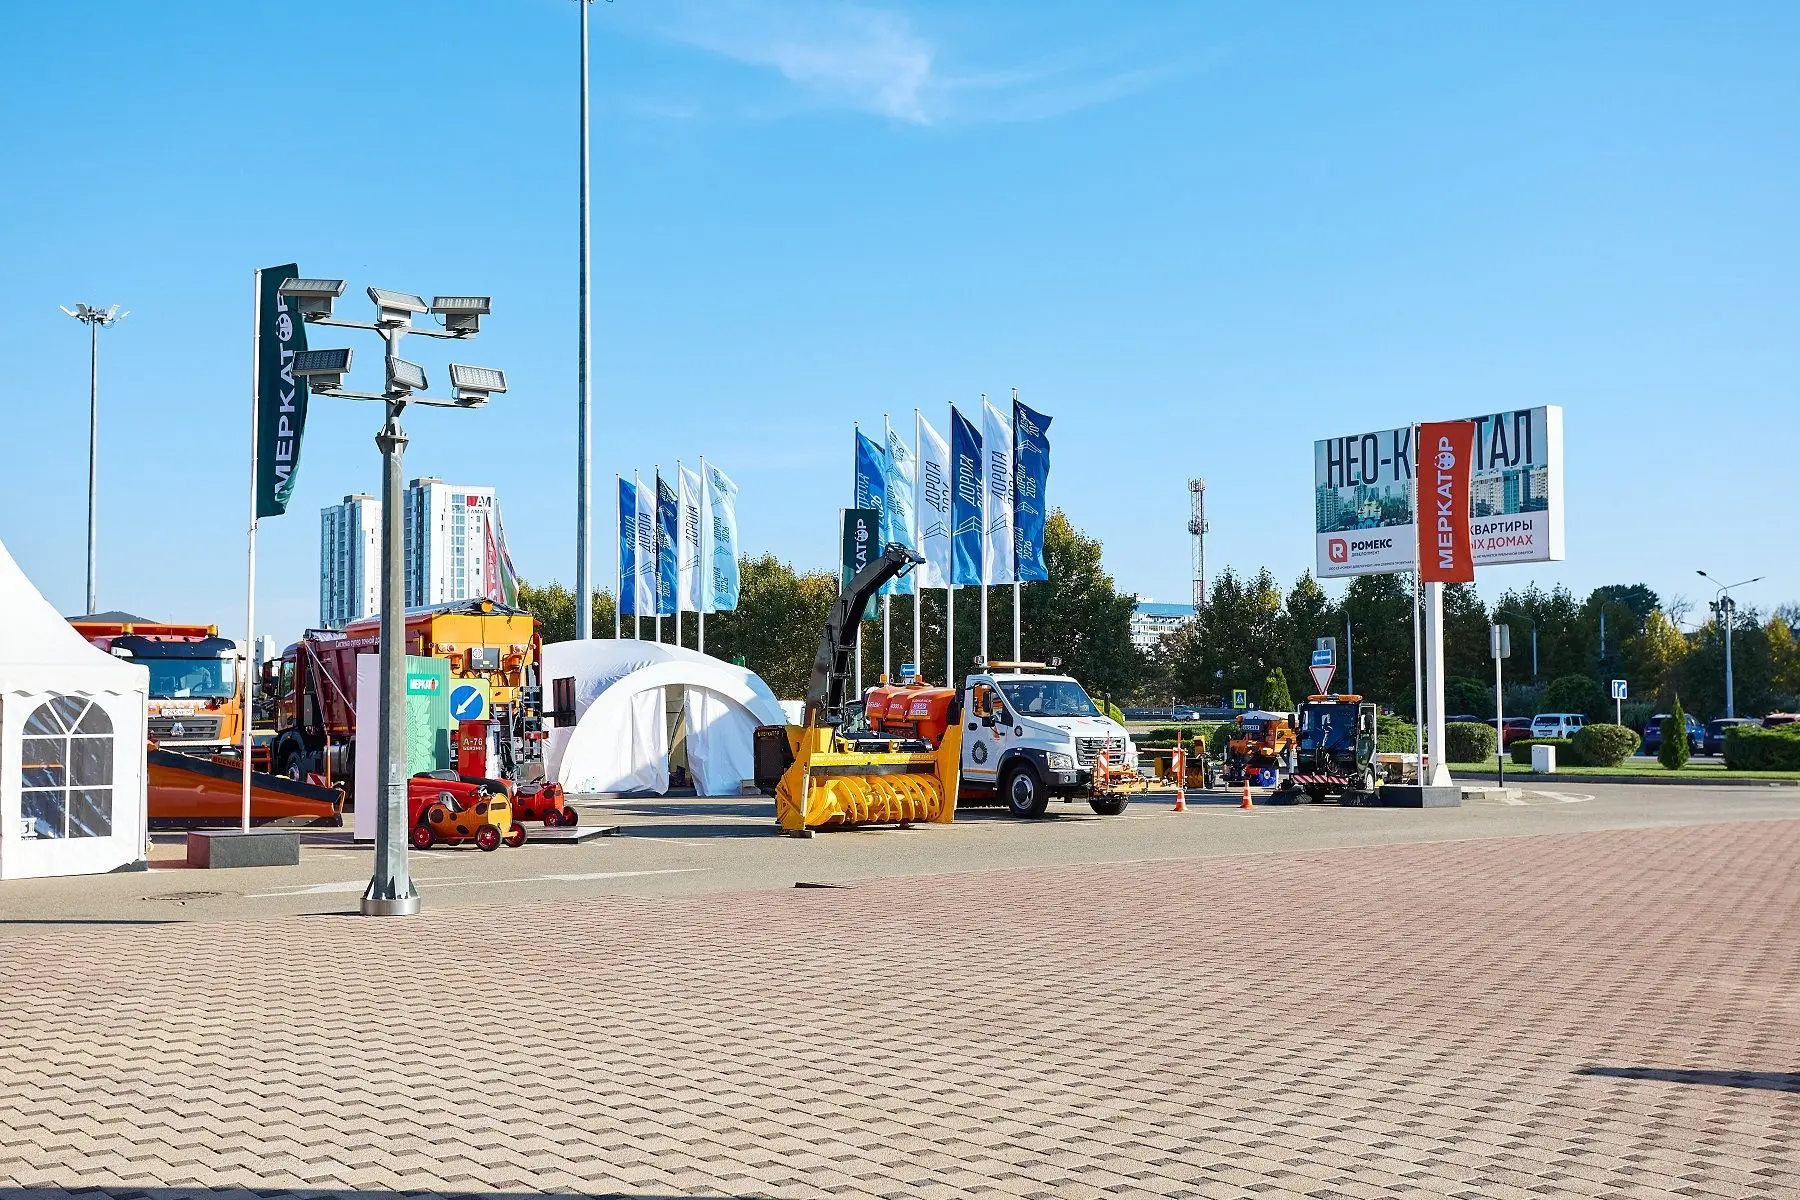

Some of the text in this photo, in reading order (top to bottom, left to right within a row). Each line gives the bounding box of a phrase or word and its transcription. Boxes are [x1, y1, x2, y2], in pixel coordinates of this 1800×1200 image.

[1326, 409, 1534, 490] НЕО-КТАЛ
[925, 460, 942, 512] ДОРОГА
[959, 453, 976, 507] ДОРОГА
[991, 450, 1008, 504] ДОРОГА
[1025, 477, 1036, 499] 2026
[1434, 436, 1456, 569] МЕРКАТОР
[637, 512, 652, 554] ДОРОГА
[684, 504, 700, 548] ДОРОГА
[721, 526, 730, 543] 2026
[1022, 538, 1034, 561] 2026
[1351, 538, 1393, 551] РОМЕКС
[1487, 535, 1533, 550] ДОМАХ
[720, 576, 729, 594] 2026
[212, 755, 240, 768] BUCHER
